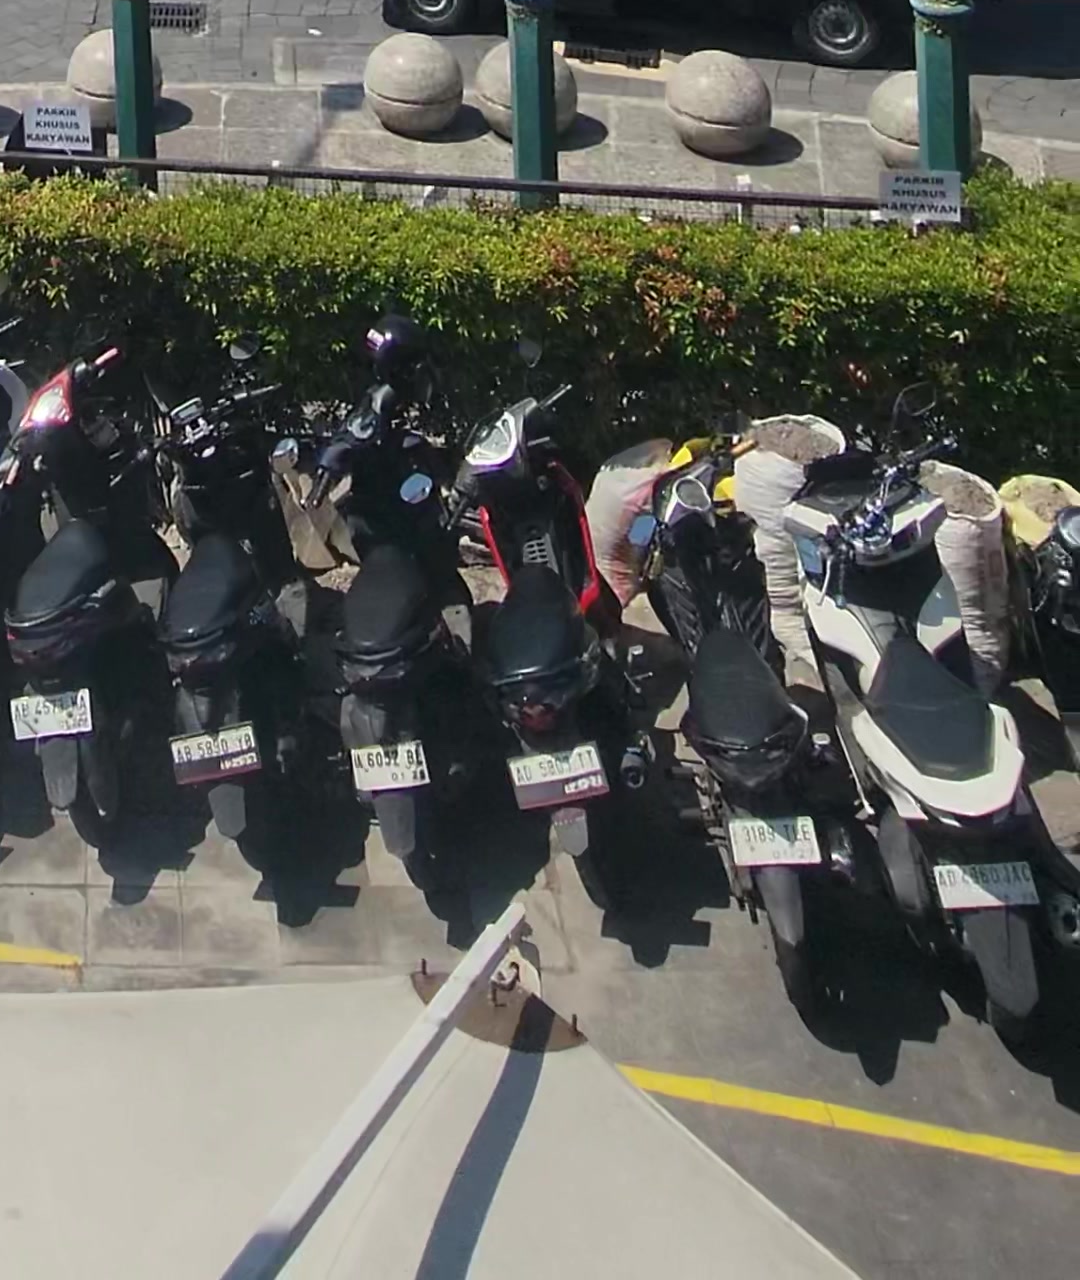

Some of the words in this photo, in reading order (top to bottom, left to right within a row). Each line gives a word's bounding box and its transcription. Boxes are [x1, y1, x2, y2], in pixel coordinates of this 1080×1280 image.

[36, 107, 77, 117] PARKIR
[35, 120, 80, 130] KHUSUS
[26, 133, 90, 144] KARYAWAN
[894, 175, 944, 185] PARKIR
[891, 189, 947, 199] KHUSUS
[15, 702, 30, 720] AB
[176, 744, 192, 763] AB
